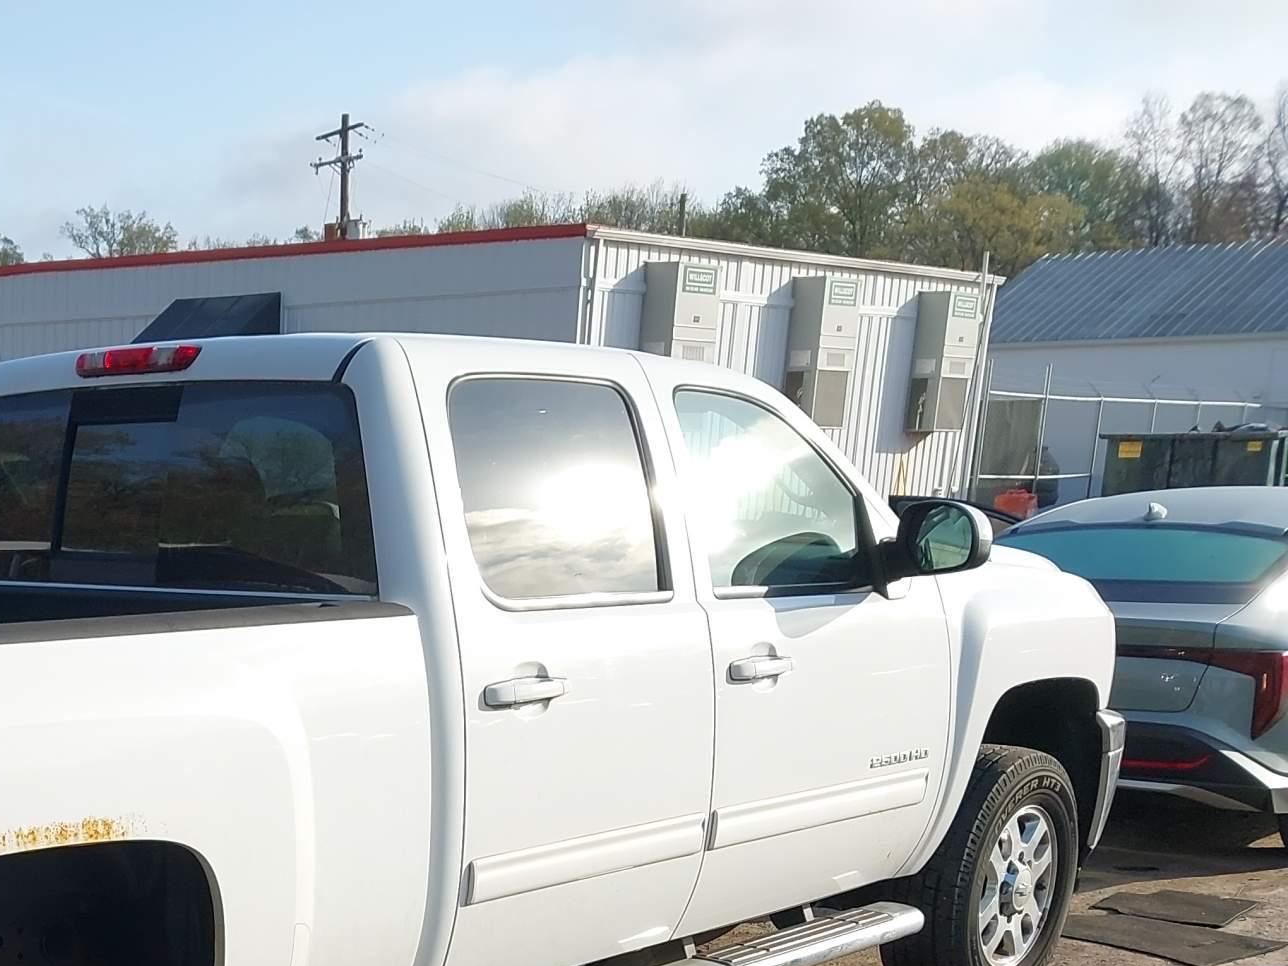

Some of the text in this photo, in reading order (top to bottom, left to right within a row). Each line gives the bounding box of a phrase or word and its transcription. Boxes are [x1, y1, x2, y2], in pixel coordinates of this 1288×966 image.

[869, 747, 929, 769] 2500 HD
[1041, 776, 1062, 793] HT3
